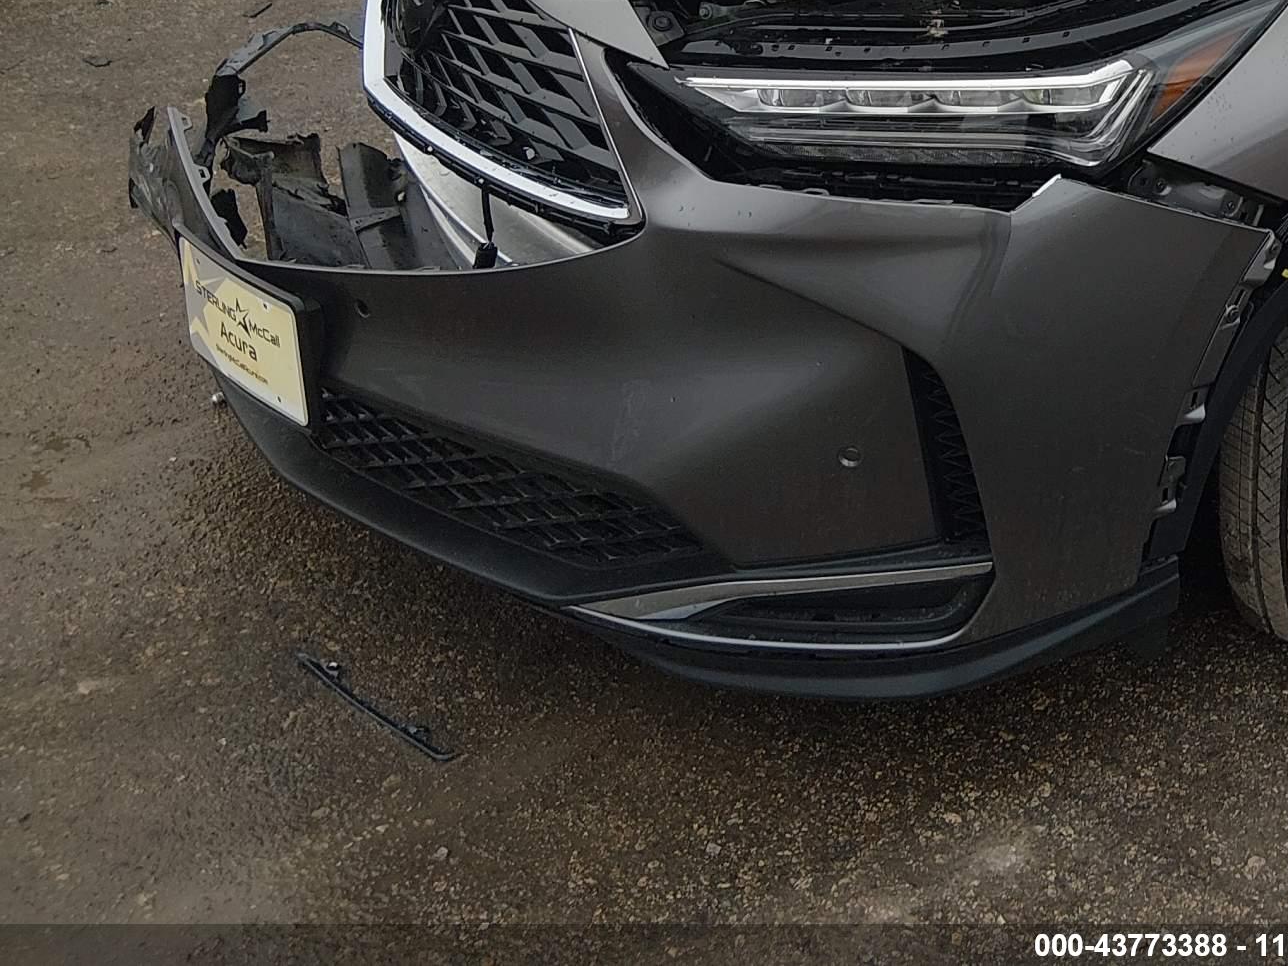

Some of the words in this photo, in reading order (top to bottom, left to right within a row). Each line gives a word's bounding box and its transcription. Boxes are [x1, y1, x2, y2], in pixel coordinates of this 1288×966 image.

[195, 280, 237, 322] STERLING
[248, 318, 281, 348] McCall
[220, 322, 258, 362] Acura
